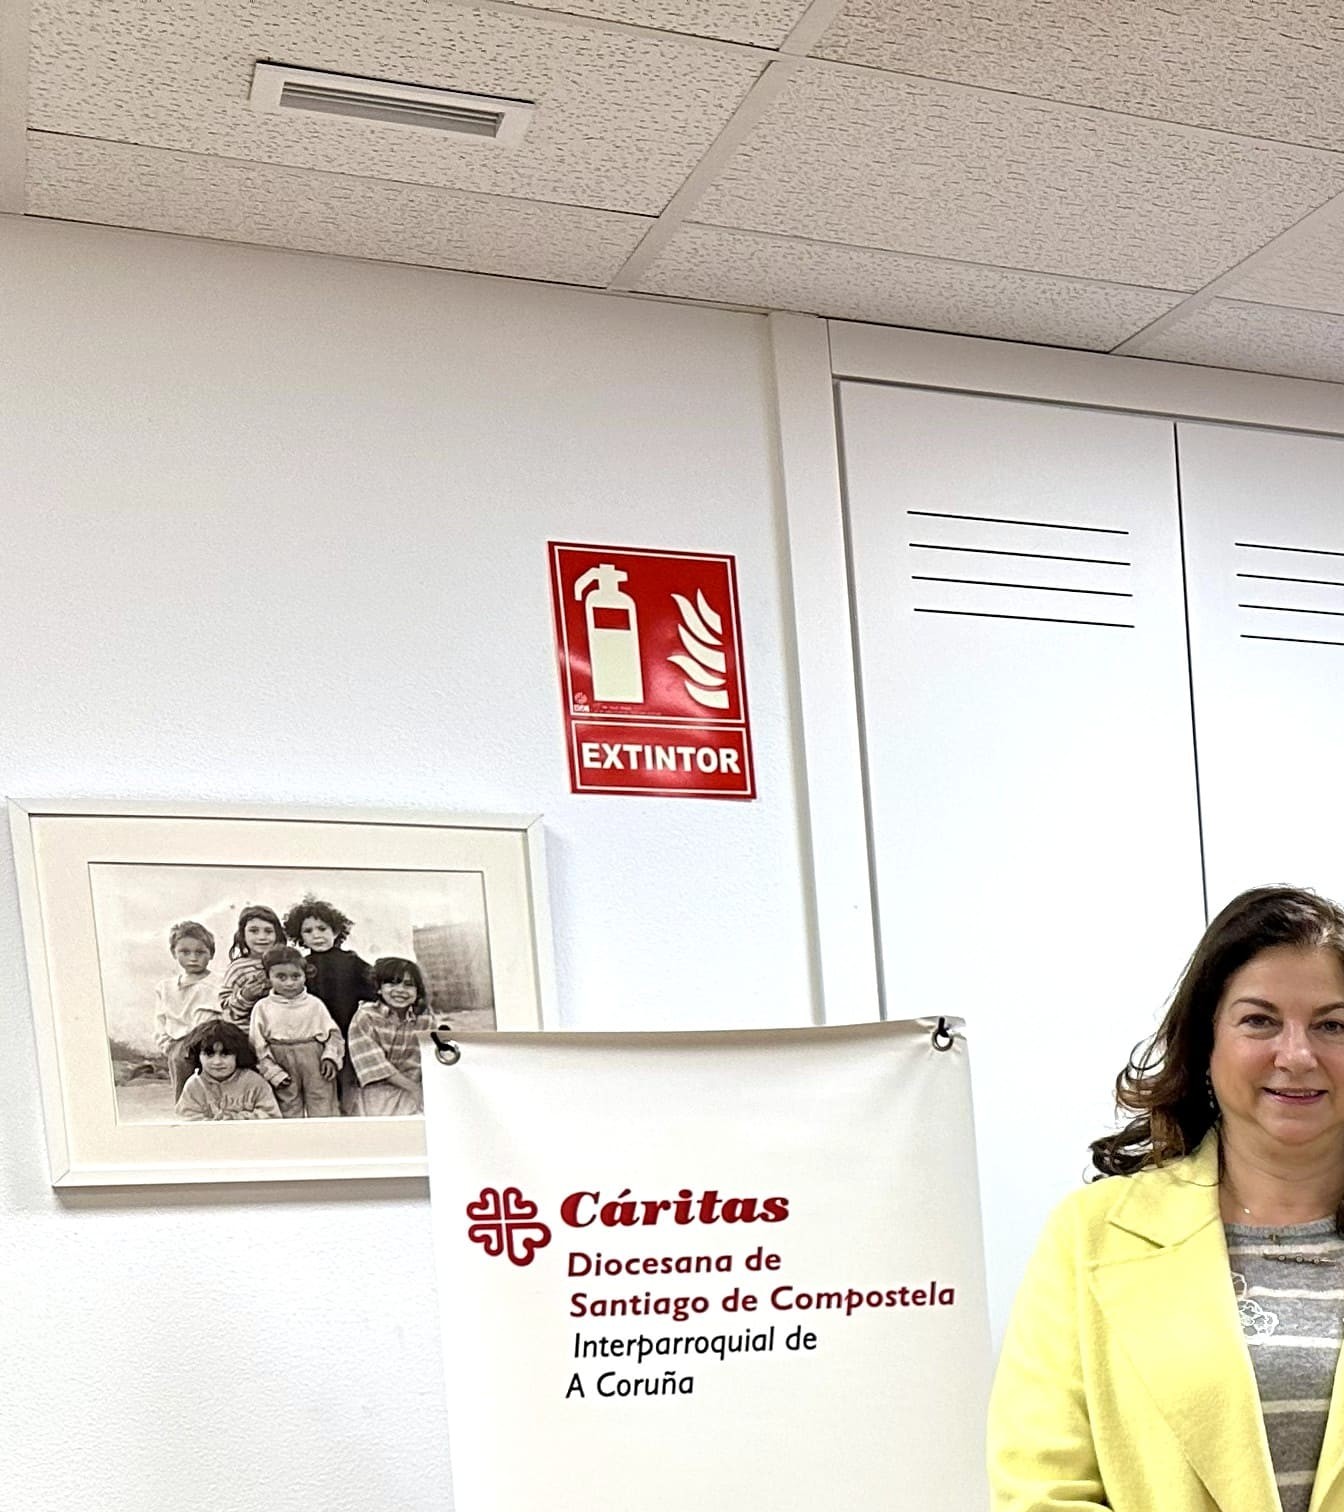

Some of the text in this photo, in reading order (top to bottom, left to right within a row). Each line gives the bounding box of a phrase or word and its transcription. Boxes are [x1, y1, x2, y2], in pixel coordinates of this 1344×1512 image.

[581, 742, 741, 774] EXTINTOR
[559, 1187, 790, 1229] Cáritas
[567, 1245, 782, 1278] Diocesana de
[569, 1280, 955, 1323] Santiago de Compostela
[574, 1324, 818, 1365] Interparroquial de
[564, 1370, 694, 1400] A Coruña
